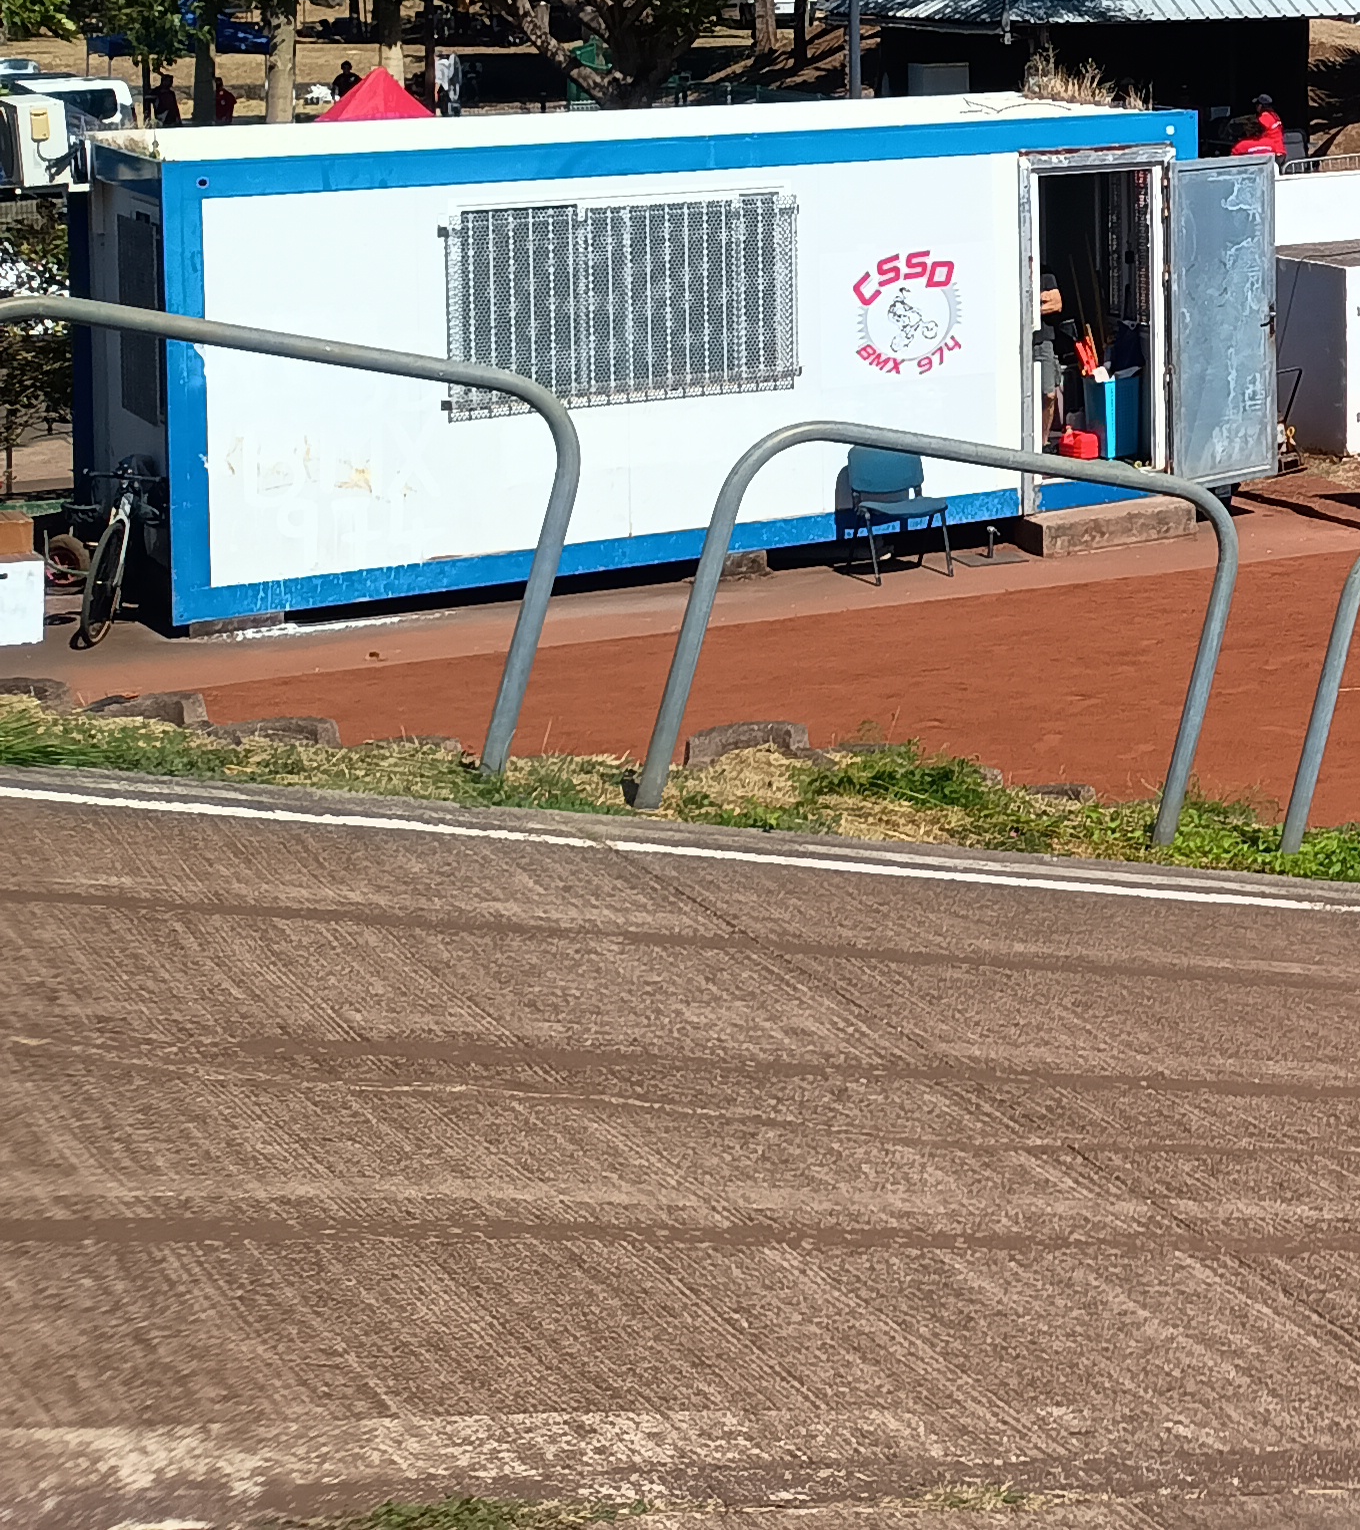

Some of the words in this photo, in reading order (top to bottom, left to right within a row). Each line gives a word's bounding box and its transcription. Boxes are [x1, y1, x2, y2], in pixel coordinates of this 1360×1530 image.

[853, 250, 955, 306] CSSD
[856, 344, 905, 375] BMX
[917, 335, 962, 375] 974
